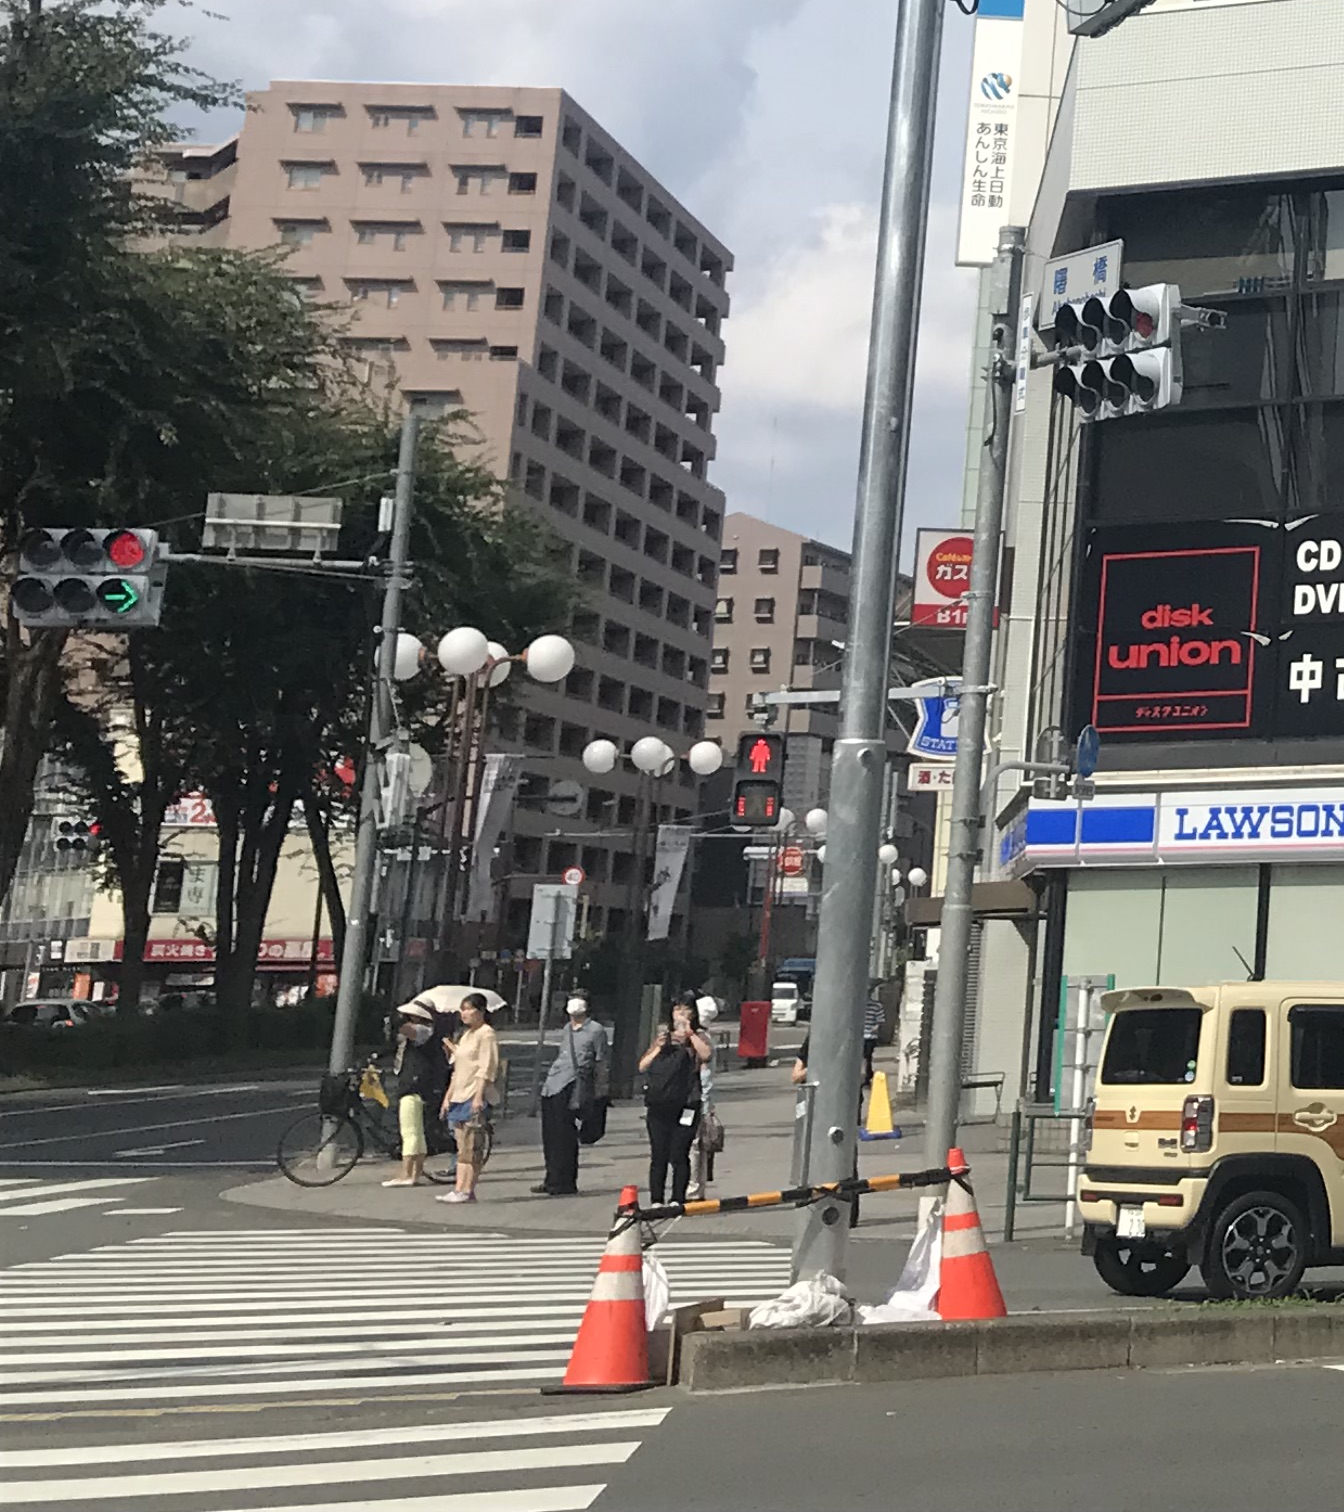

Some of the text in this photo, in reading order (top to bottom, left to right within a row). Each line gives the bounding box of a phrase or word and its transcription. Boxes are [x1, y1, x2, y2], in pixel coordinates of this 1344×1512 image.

[970, 121, 992, 207] あんしん生命
[987, 122, 1009, 208] 東京海上日動
[1141, 603, 1214, 630] disk
[1108, 635, 1241, 669] union
[1135, 705, 1208, 718] ディスクユニオン
